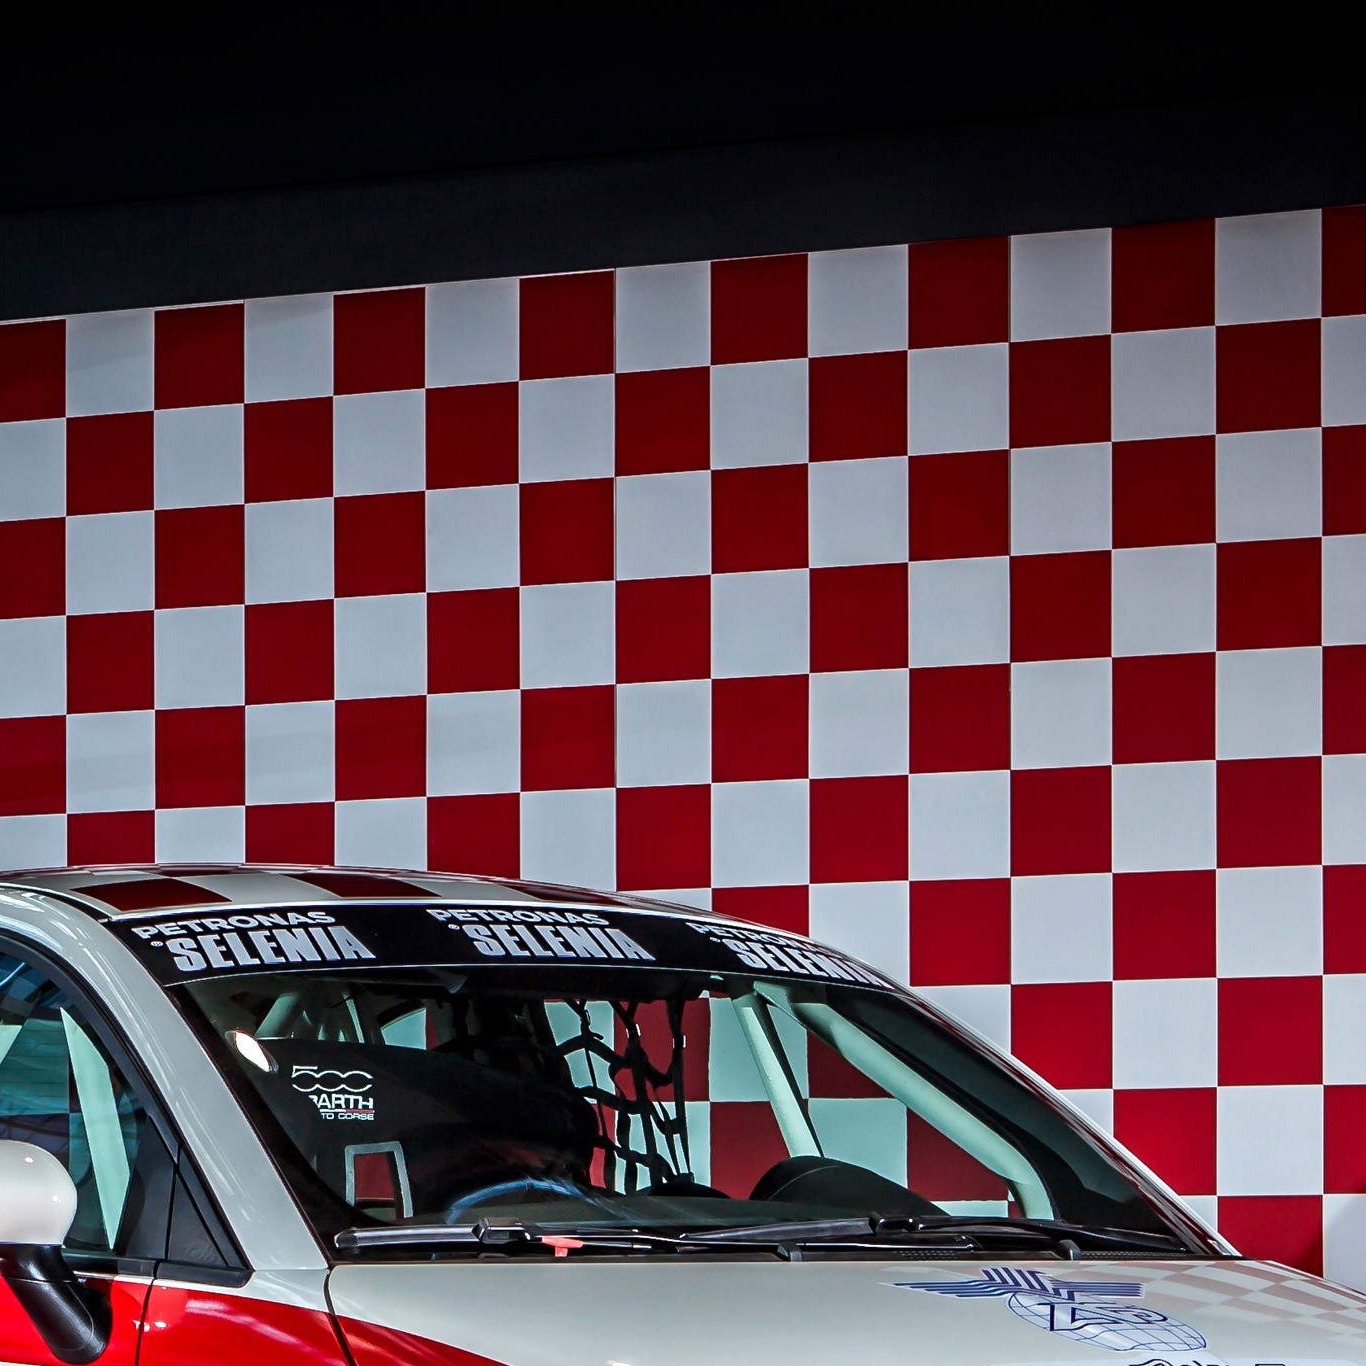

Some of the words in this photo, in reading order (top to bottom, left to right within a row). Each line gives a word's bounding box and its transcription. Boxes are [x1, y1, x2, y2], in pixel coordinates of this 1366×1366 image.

[131, 911, 336, 939] PETRONAS
[426, 909, 610, 926] PETRONAS
[165, 925, 376, 972] SELENIA
[461, 923, 656, 961] SELENIA
[721, 938, 895, 990] SELENIA
[291, 1065, 373, 1092] 500
[308, 1093, 374, 1109] ARTH
[338, 1112, 374, 1120] CORSE
